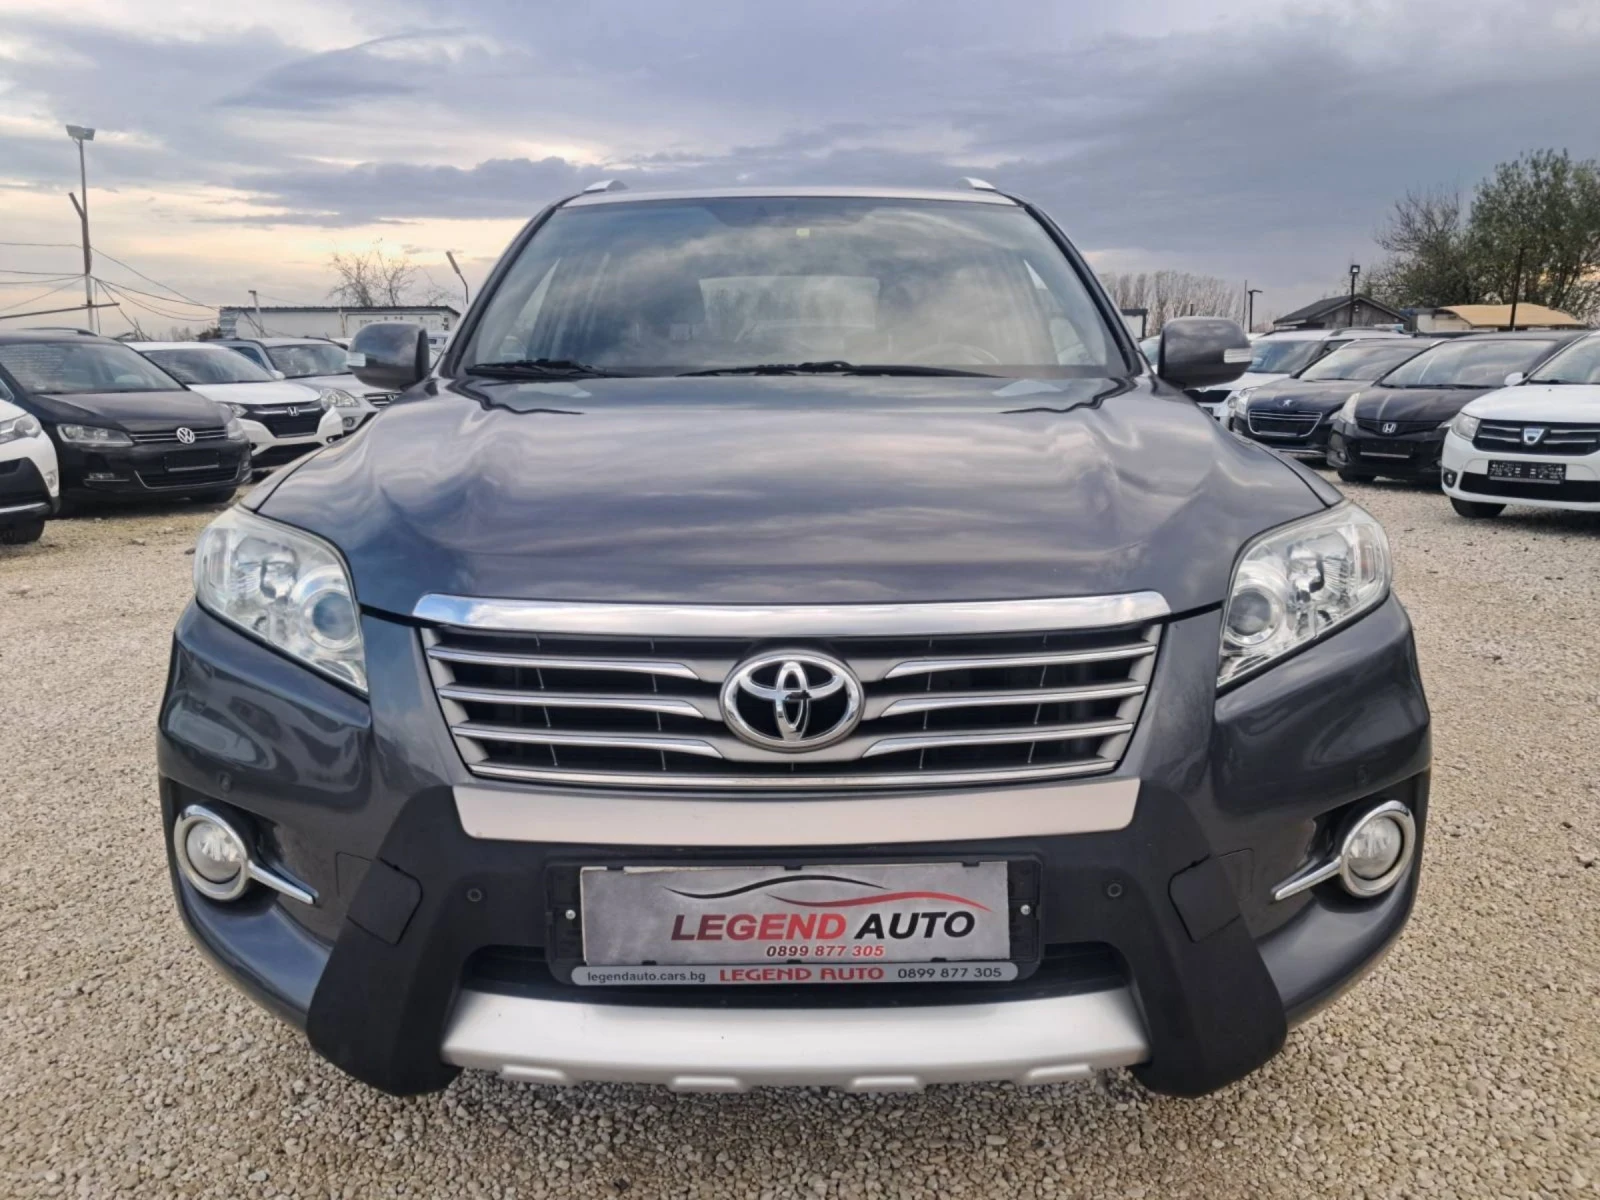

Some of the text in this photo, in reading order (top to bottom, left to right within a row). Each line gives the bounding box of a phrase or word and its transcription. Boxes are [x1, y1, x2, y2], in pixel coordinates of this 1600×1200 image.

[670, 911, 976, 941] LEGEND AUTO
[766, 945, 885, 957] 0899 877 305
[587, 971, 706, 983] legendauto.cars.bg
[719, 967, 884, 982] LEGEND AUTO
[897, 967, 1002, 979] 0899 877 305
